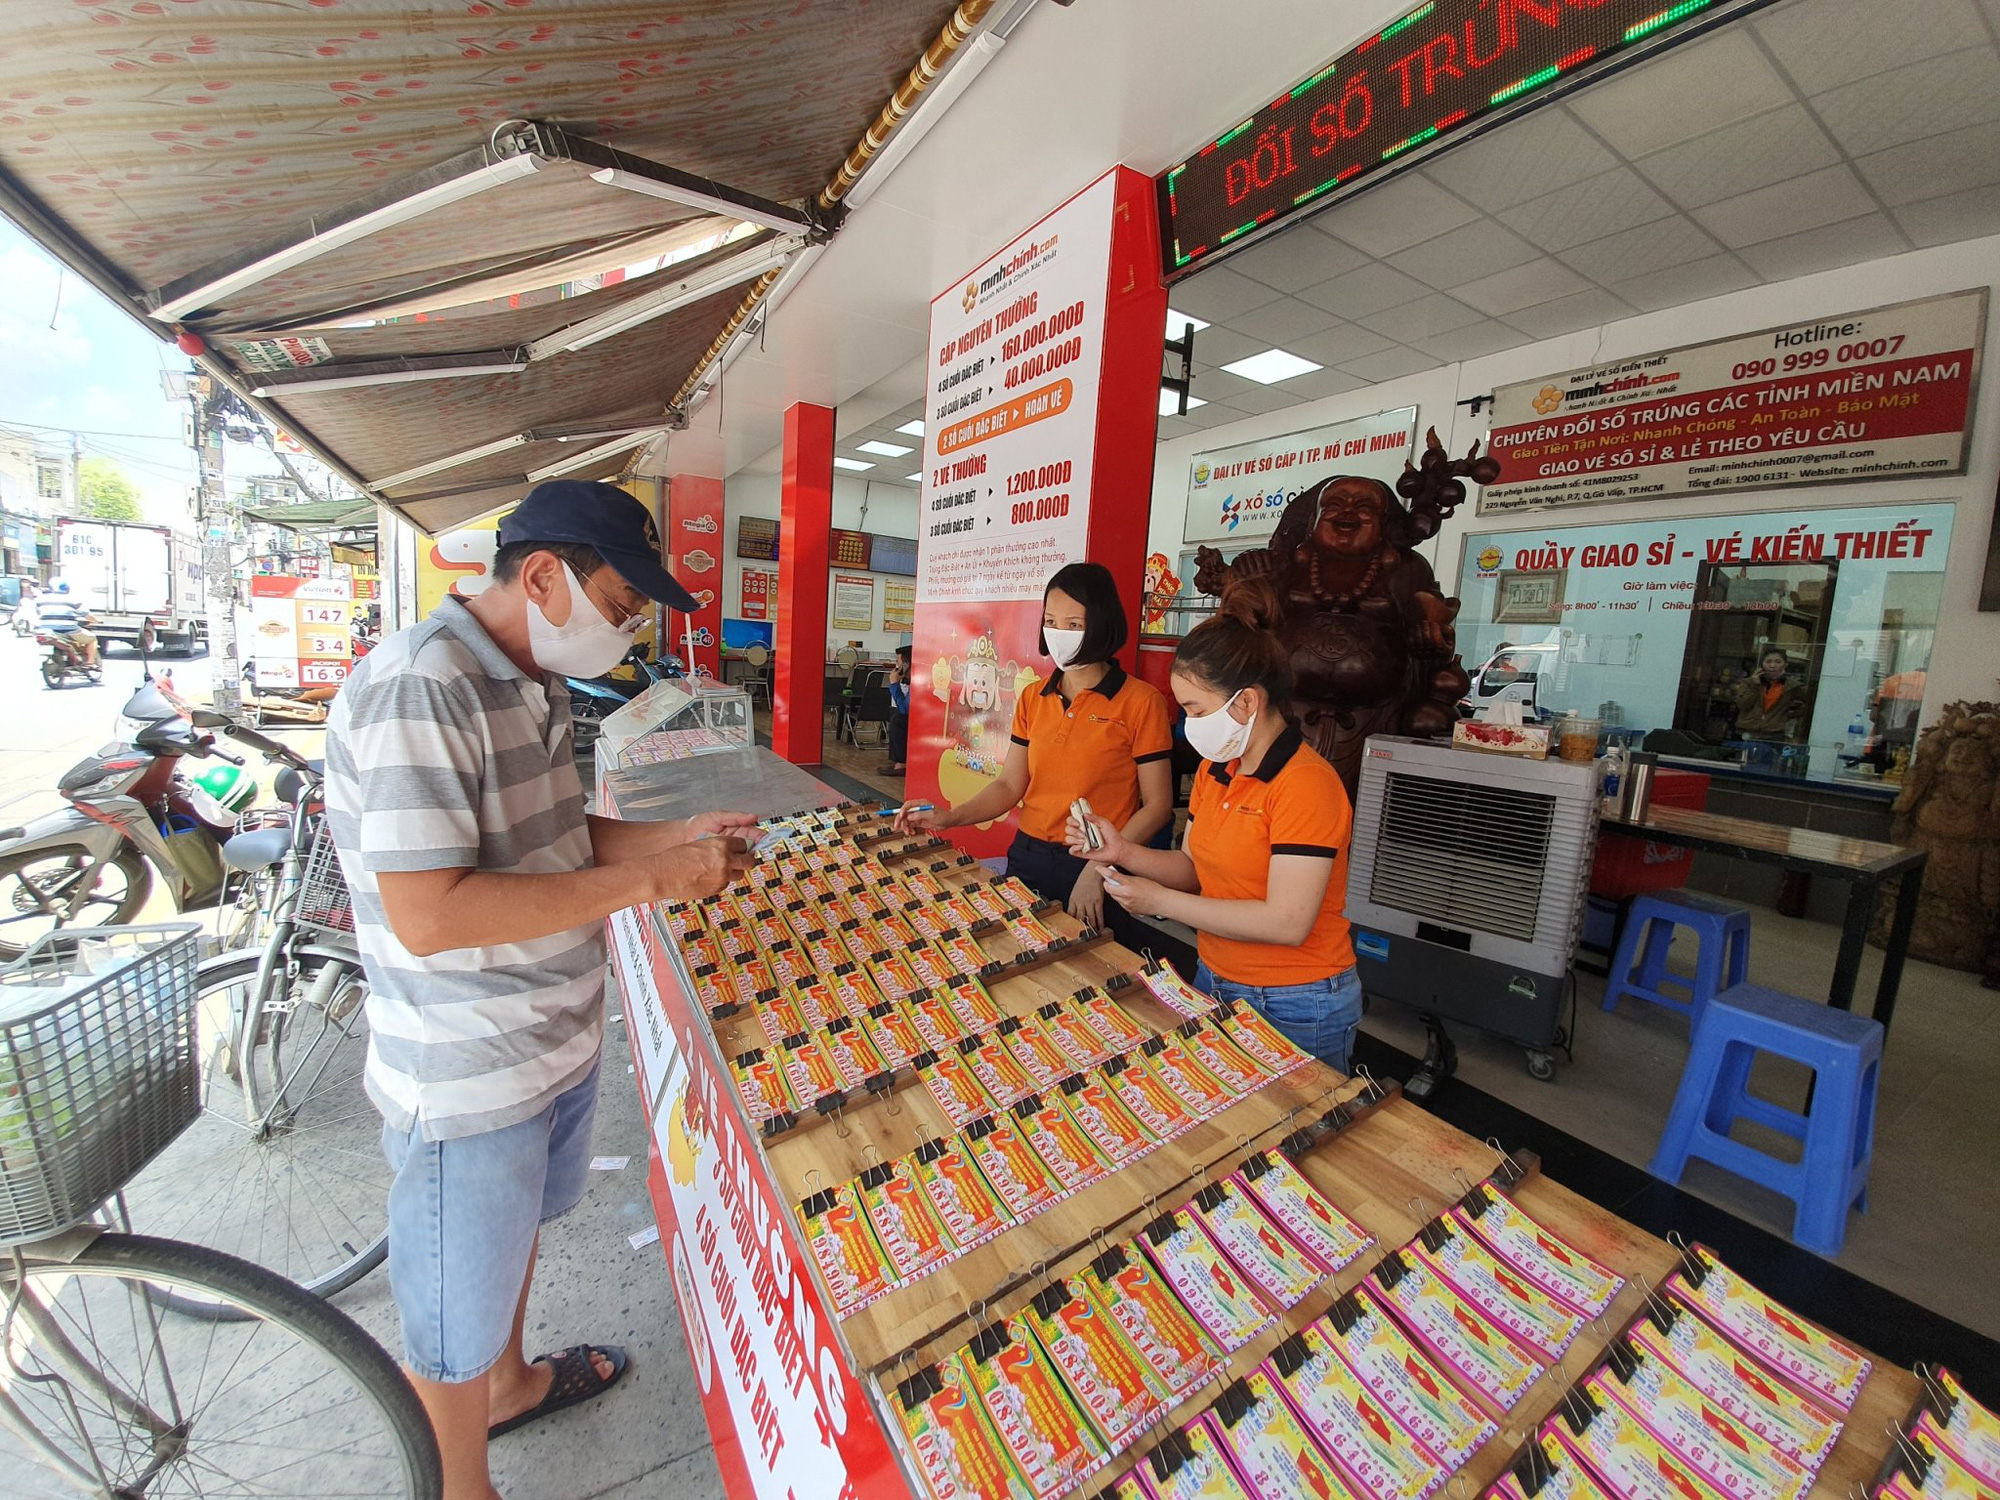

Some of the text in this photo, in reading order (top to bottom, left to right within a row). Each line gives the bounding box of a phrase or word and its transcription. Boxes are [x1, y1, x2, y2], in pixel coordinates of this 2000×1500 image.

[1225, 123, 1298, 206] ĐỔI
[1310, 70, 1373, 158] SỐ
[958, 319, 992, 356] NGUYÊN
[1002, 300, 1084, 362] 160.000.000Đ
[1731, 335, 1906, 380] 090 999 0007
[1774, 321, 1862, 349] Hotline:
[1004, 336, 1082, 390] 40.000.000Đ
[1622, 362, 1642, 373] KIẾN
[1644, 355, 1668, 369] THIẾT
[943, 436, 948, 449] 2
[949, 428, 956, 447] SỐ
[958, 420, 974, 442] CUỐI
[992, 410, 1008, 432] BIỆT
[1025, 393, 1048, 419] HOÀN
[1051, 385, 1063, 407] VÉ
[1493, 362, 1961, 448] CHUYÊN ĐỔI SỐ TRÚNG CÁC TỈNH MIỀN NAM
[1512, 392, 1920, 459] Giao Tiền Tận Nơi: Nhanh Chóng An Toàn Bảo Mật
[933, 470, 938, 487] 2
[940, 462, 950, 485] VÉ
[1214, 466, 1229, 481] ĐẠI
[1231, 461, 1242, 476] LÝ
[1244, 458, 1256, 475] VÉ
[1259, 454, 1272, 471] SỐ
[1306, 448, 1320, 463] TP.
[1344, 436, 1366, 457] CHÍ
[1370, 430, 1407, 452] MINH
[1539, 459, 1580, 476] GIAO
[1584, 453, 1606, 469] VÉ
[1638, 444, 1656, 463] SỈ
[1660, 446, 1676, 460] &
[1680, 438, 1702, 458] LẺ
[1707, 435, 1762, 454] THEO
[1769, 430, 1810, 446] YÊU
[1817, 420, 1866, 441] CẦU
[1688, 464, 1719, 474] Email:
[1006, 460, 1072, 496] 1.200.000Đ
[1244, 490, 1263, 510] XỔ
[1266, 487, 1284, 508] SỐ
[1524, 483, 1541, 493] kinh
[1542, 482, 1567, 492] doanh
[1628, 484, 1664, 494] TP.HCM
[1688, 478, 1710, 488] Tổng
[1712, 477, 1732, 486] đài:
[1735, 473, 1761, 484] 1900
[1762, 471, 1788, 481] 6131
[1800, 466, 1849, 478] Website:
[1011, 494, 1070, 525] 800.000Đ
[1515, 540, 1575, 572] QUẦY
[1580, 542, 1639, 568] GIAO
[1646, 533, 1676, 566] SỈ
[1706, 530, 1742, 564] VÉ
[1750, 524, 1825, 562] KIẾN
[1834, 519, 1933, 560] THIẾT
[1623, 580, 1698, 591] Giờ làm việc:
[307, 610, 342, 622] 147
[308, 669, 345, 680] 16.9
[685, 1026, 847, 1436] 2 VÉ THƯỞNG
[928, 1180, 966, 1238] 384104
[872, 1207, 907, 1266] 584103
[812, 1238, 849, 1300] 984903
[1177, 1278, 1230, 1340] 095098
[696, 1203, 784, 1473] 4 SỐ CUỐI ĐẶC BIỆT
[1112, 1304, 1176, 1379] 584102
[1053, 1340, 1116, 1424] 984902
[988, 1390, 1046, 1481] 084901
